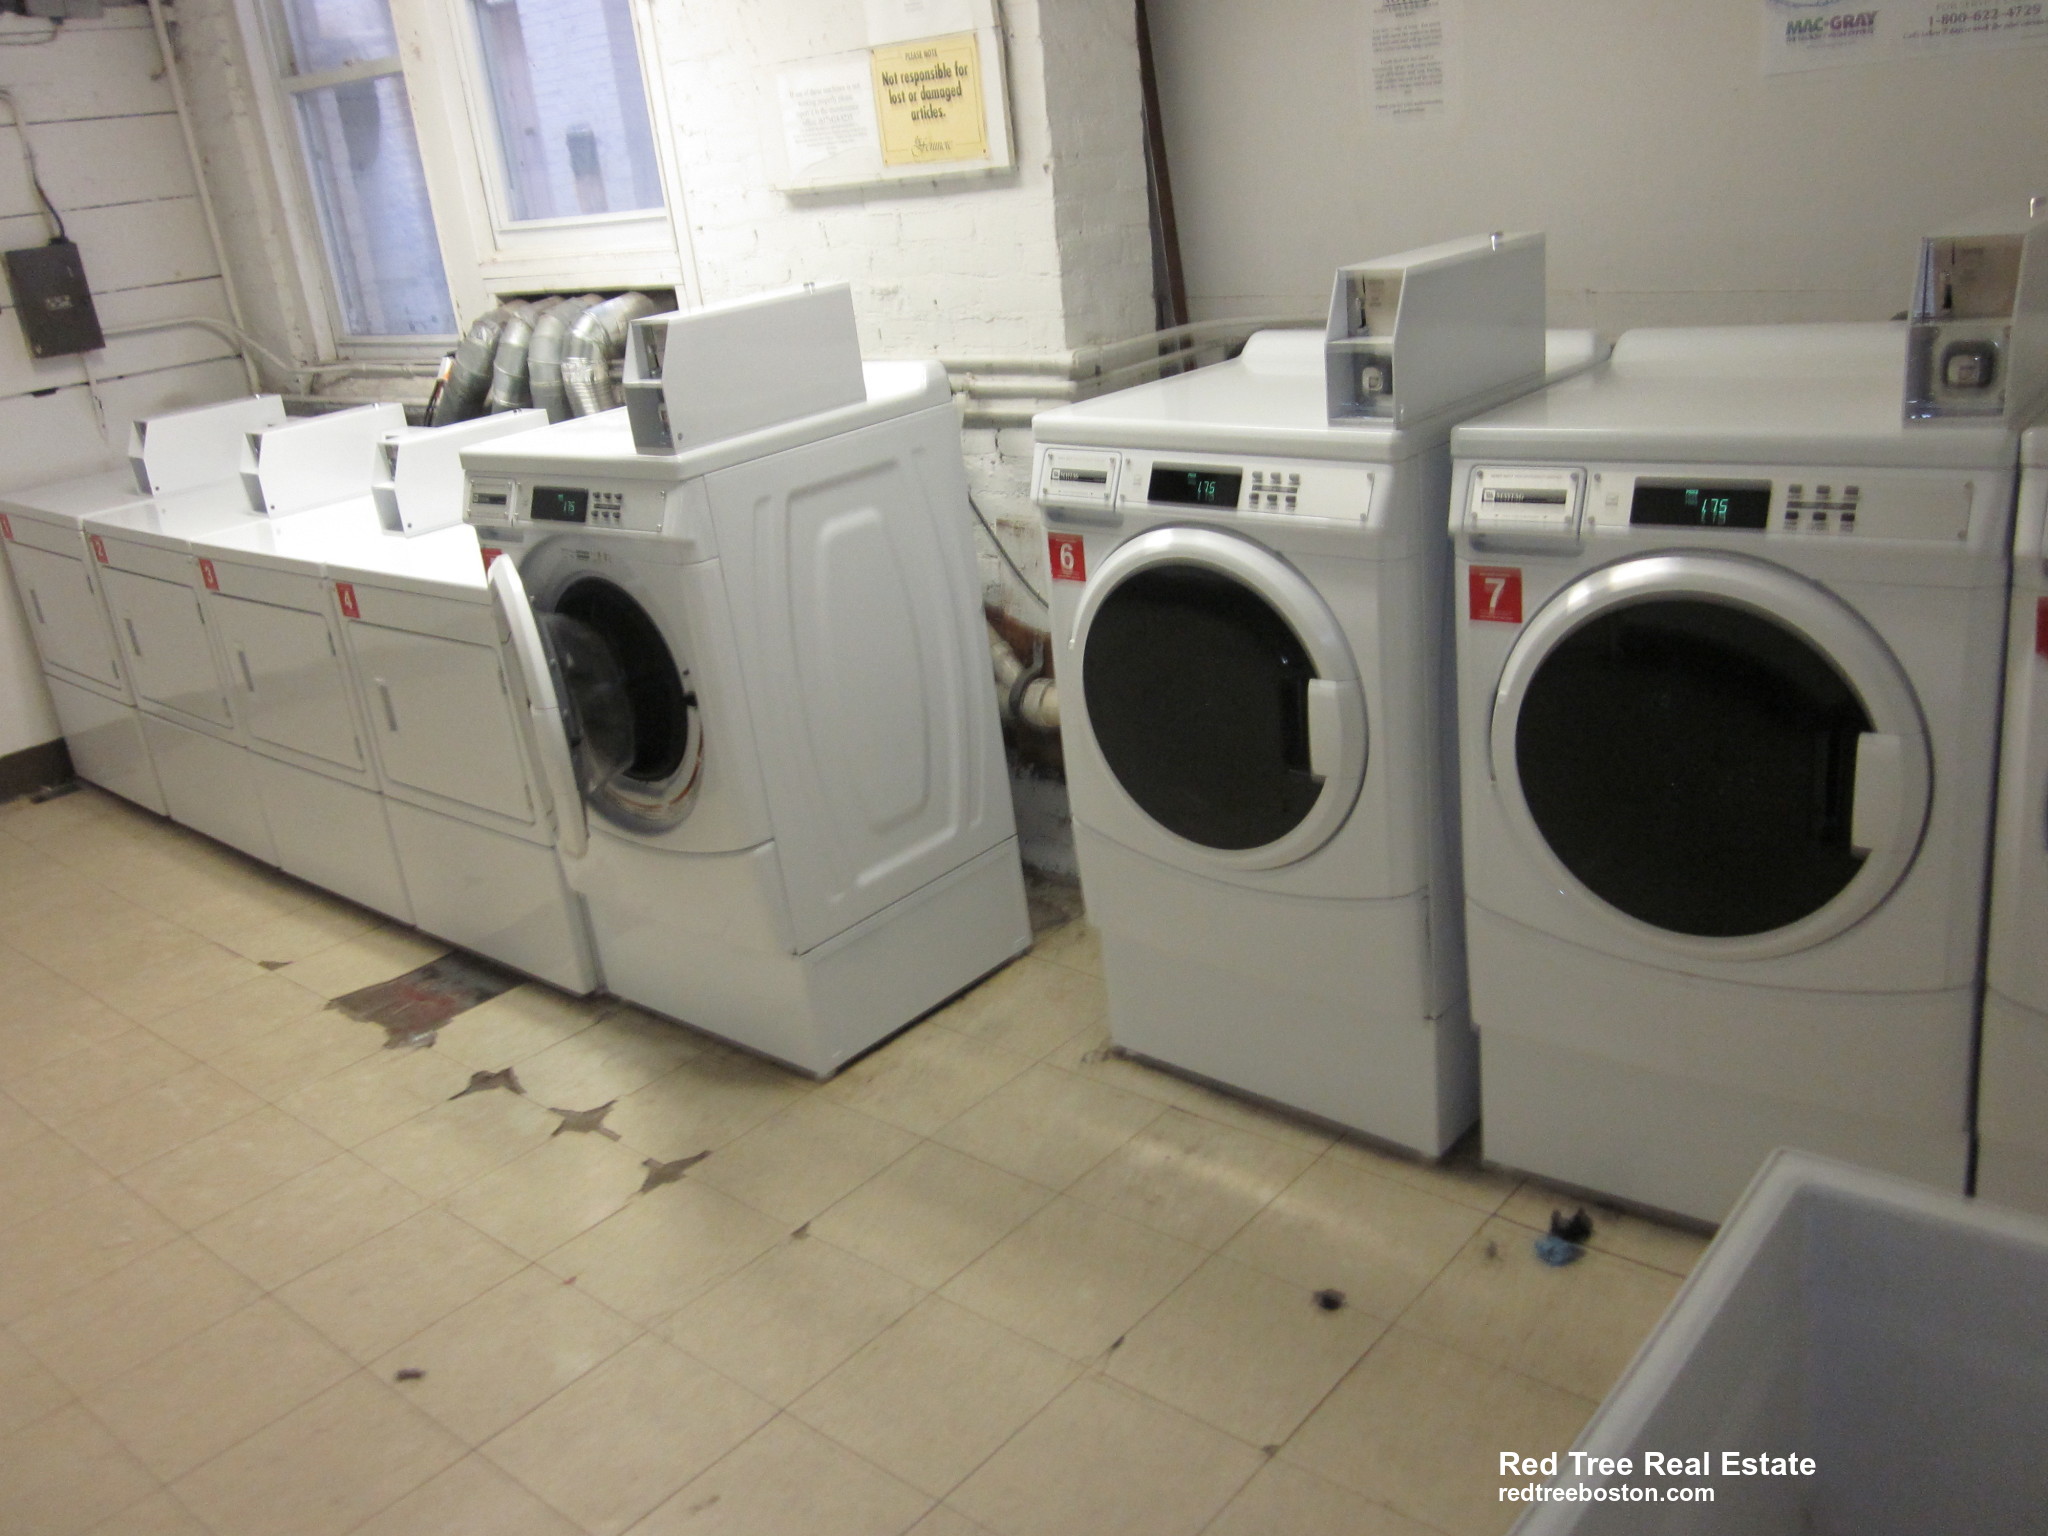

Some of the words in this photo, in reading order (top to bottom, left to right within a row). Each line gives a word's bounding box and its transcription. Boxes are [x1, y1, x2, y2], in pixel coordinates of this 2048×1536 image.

[905, 50, 922, 60] PLEASE
[924, 48, 938, 58] NOTE
[881, 71, 898, 86] Not
[900, 62, 952, 86] responsible
[954, 60, 968, 76] for
[888, 89, 906, 104] lost
[908, 91, 917, 102] or
[920, 80, 962, 102] damaged
[911, 103, 946, 120] articles.
[1060, 543, 1075, 571] 6
[205, 565, 214, 583] 3
[344, 590, 354, 609] 4
[1485, 577, 1506, 614] 7
